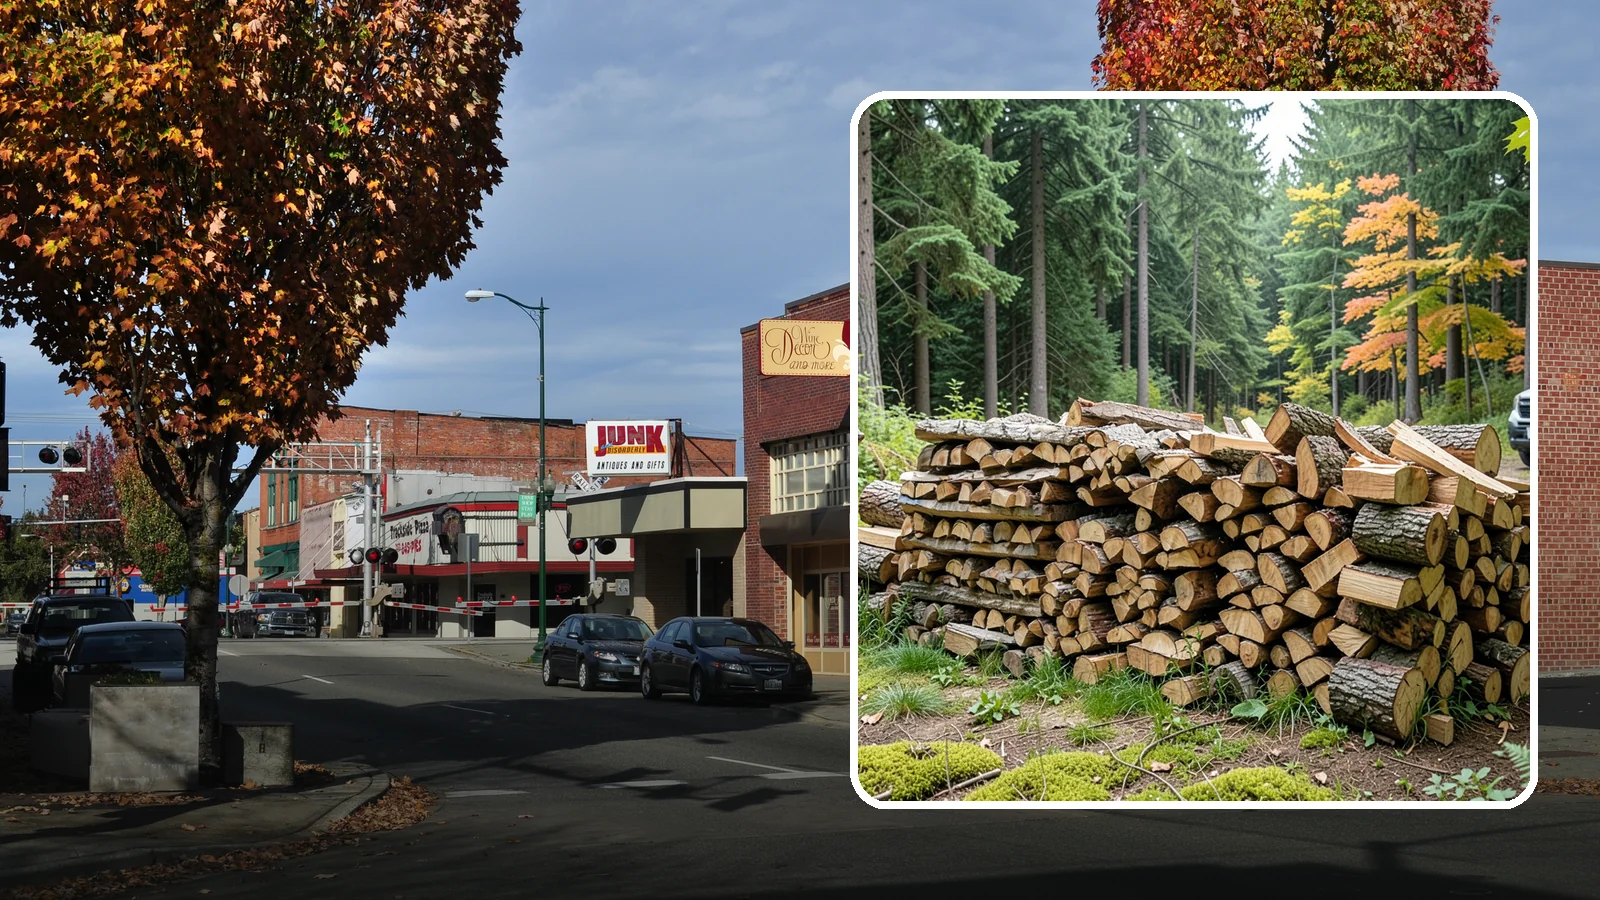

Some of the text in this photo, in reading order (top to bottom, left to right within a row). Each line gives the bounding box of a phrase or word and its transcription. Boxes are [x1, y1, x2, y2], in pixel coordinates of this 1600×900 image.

[595, 425, 665, 457] JUNK
[607, 446, 645, 454] DISORDERLY
[597, 461, 665, 470] ANTIQUES AND GIFTS
[414, 519, 429, 534] Pizza
